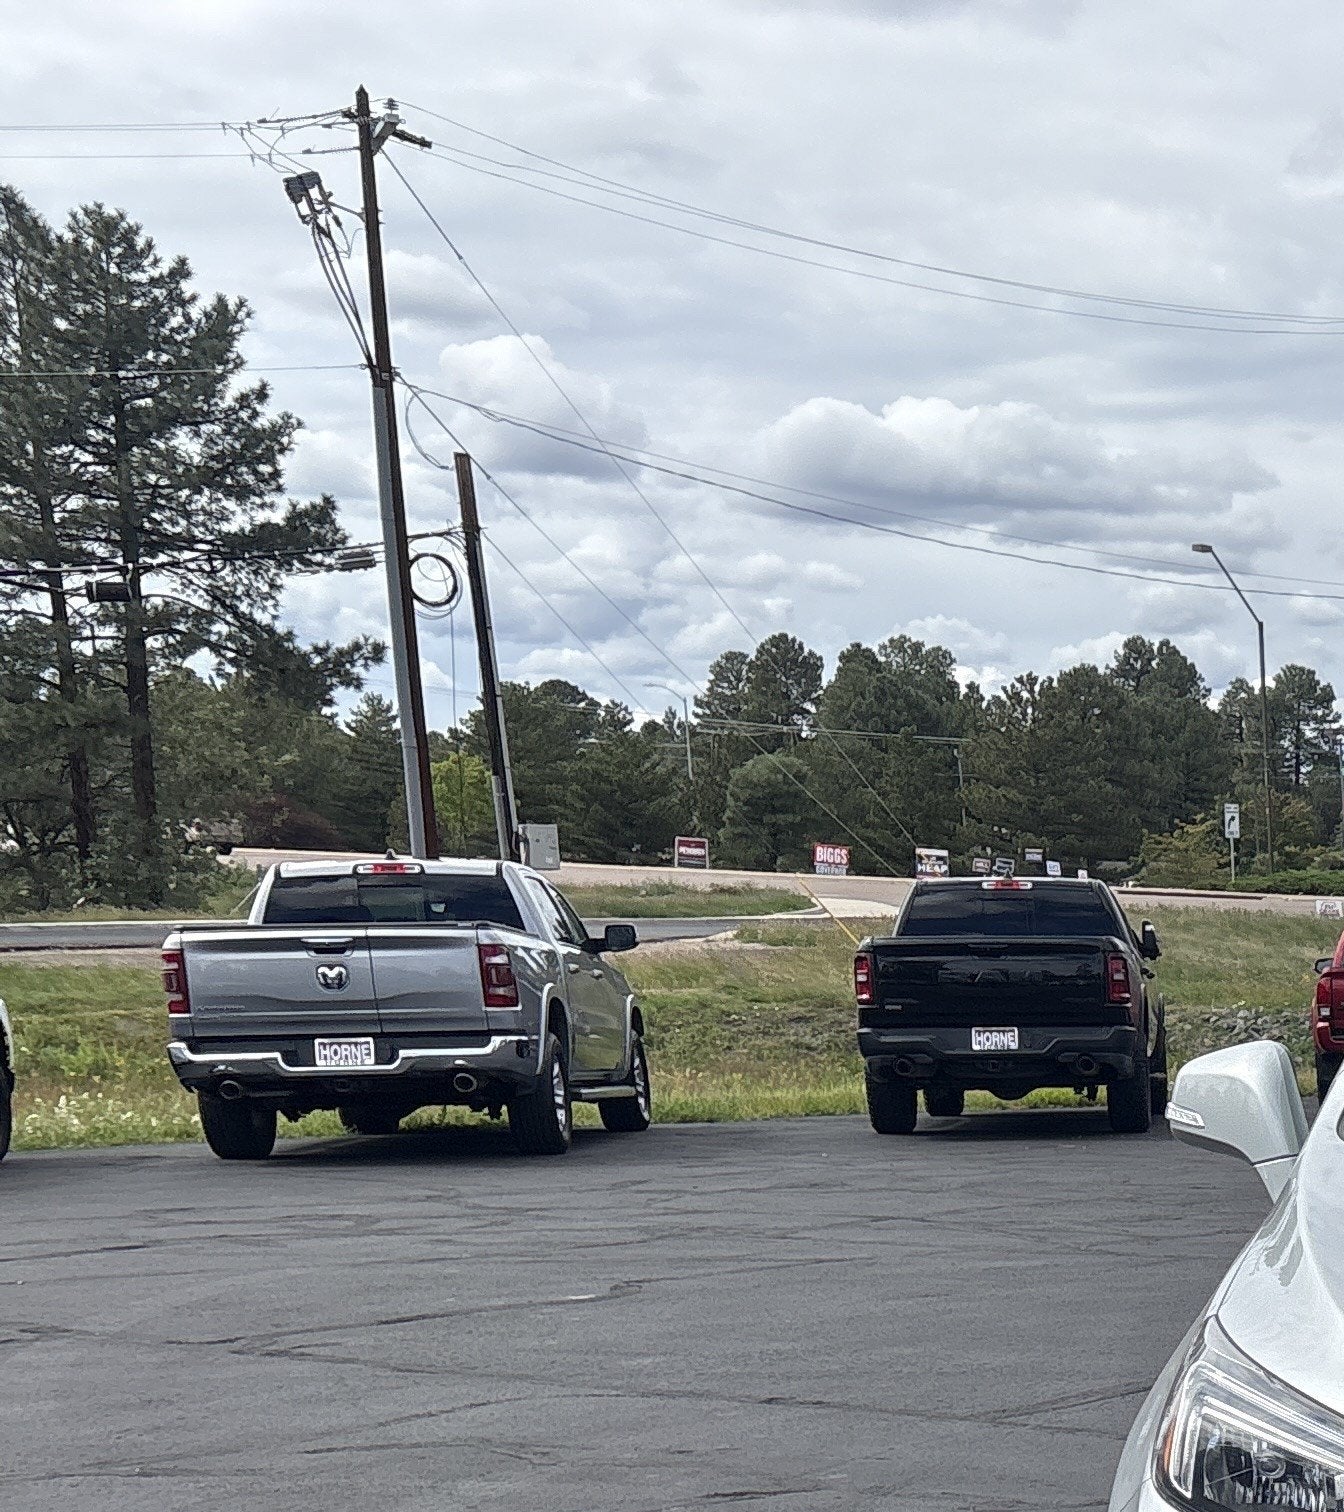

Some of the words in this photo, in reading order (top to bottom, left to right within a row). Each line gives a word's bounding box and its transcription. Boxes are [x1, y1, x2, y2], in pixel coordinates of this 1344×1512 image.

[815, 845, 849, 865] BIGGS
[975, 1031, 1016, 1046] HORNE
[318, 1043, 371, 1062] HORNE
